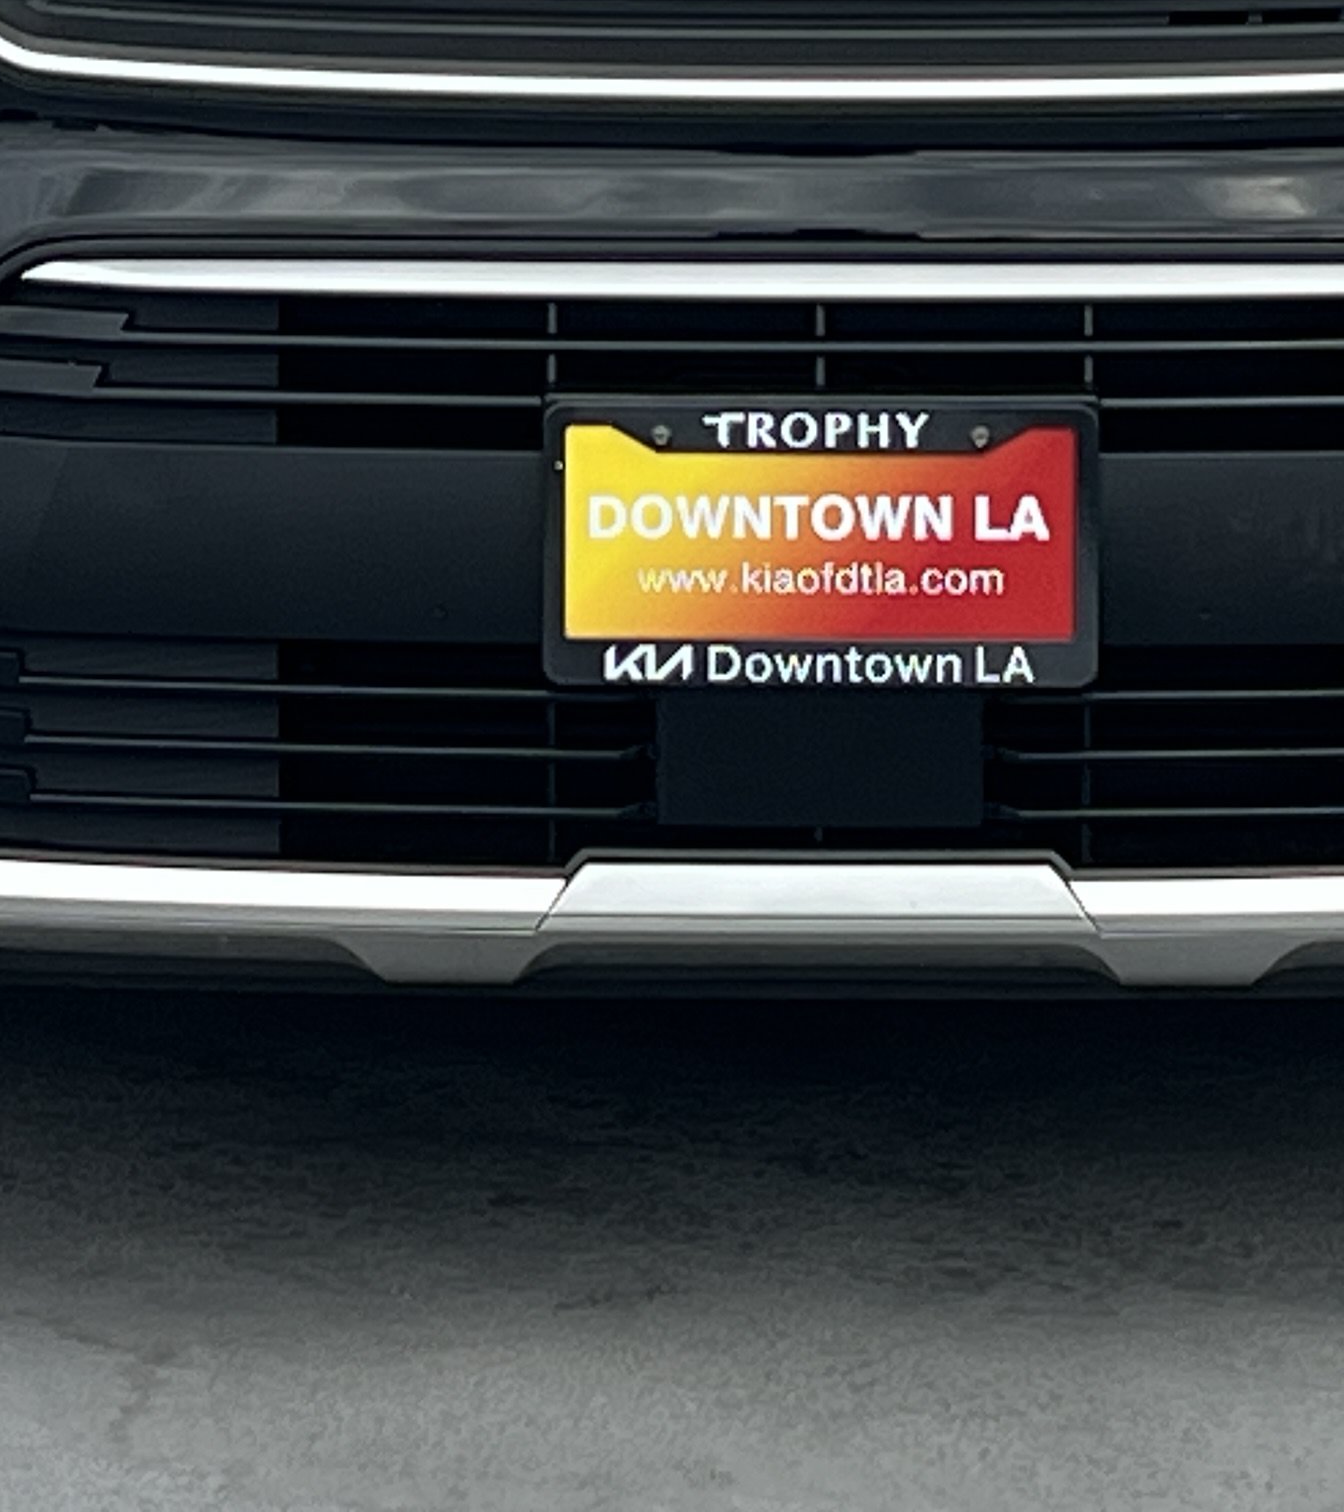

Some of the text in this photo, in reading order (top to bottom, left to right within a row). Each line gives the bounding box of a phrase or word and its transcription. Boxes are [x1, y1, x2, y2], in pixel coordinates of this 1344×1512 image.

[702, 411, 930, 450] TROPHY
[587, 493, 1050, 542] DOWNTOWN LA
[637, 562, 1005, 596] www.kiaofdtla.com
[604, 644, 1036, 684] KIA Downtown LA
